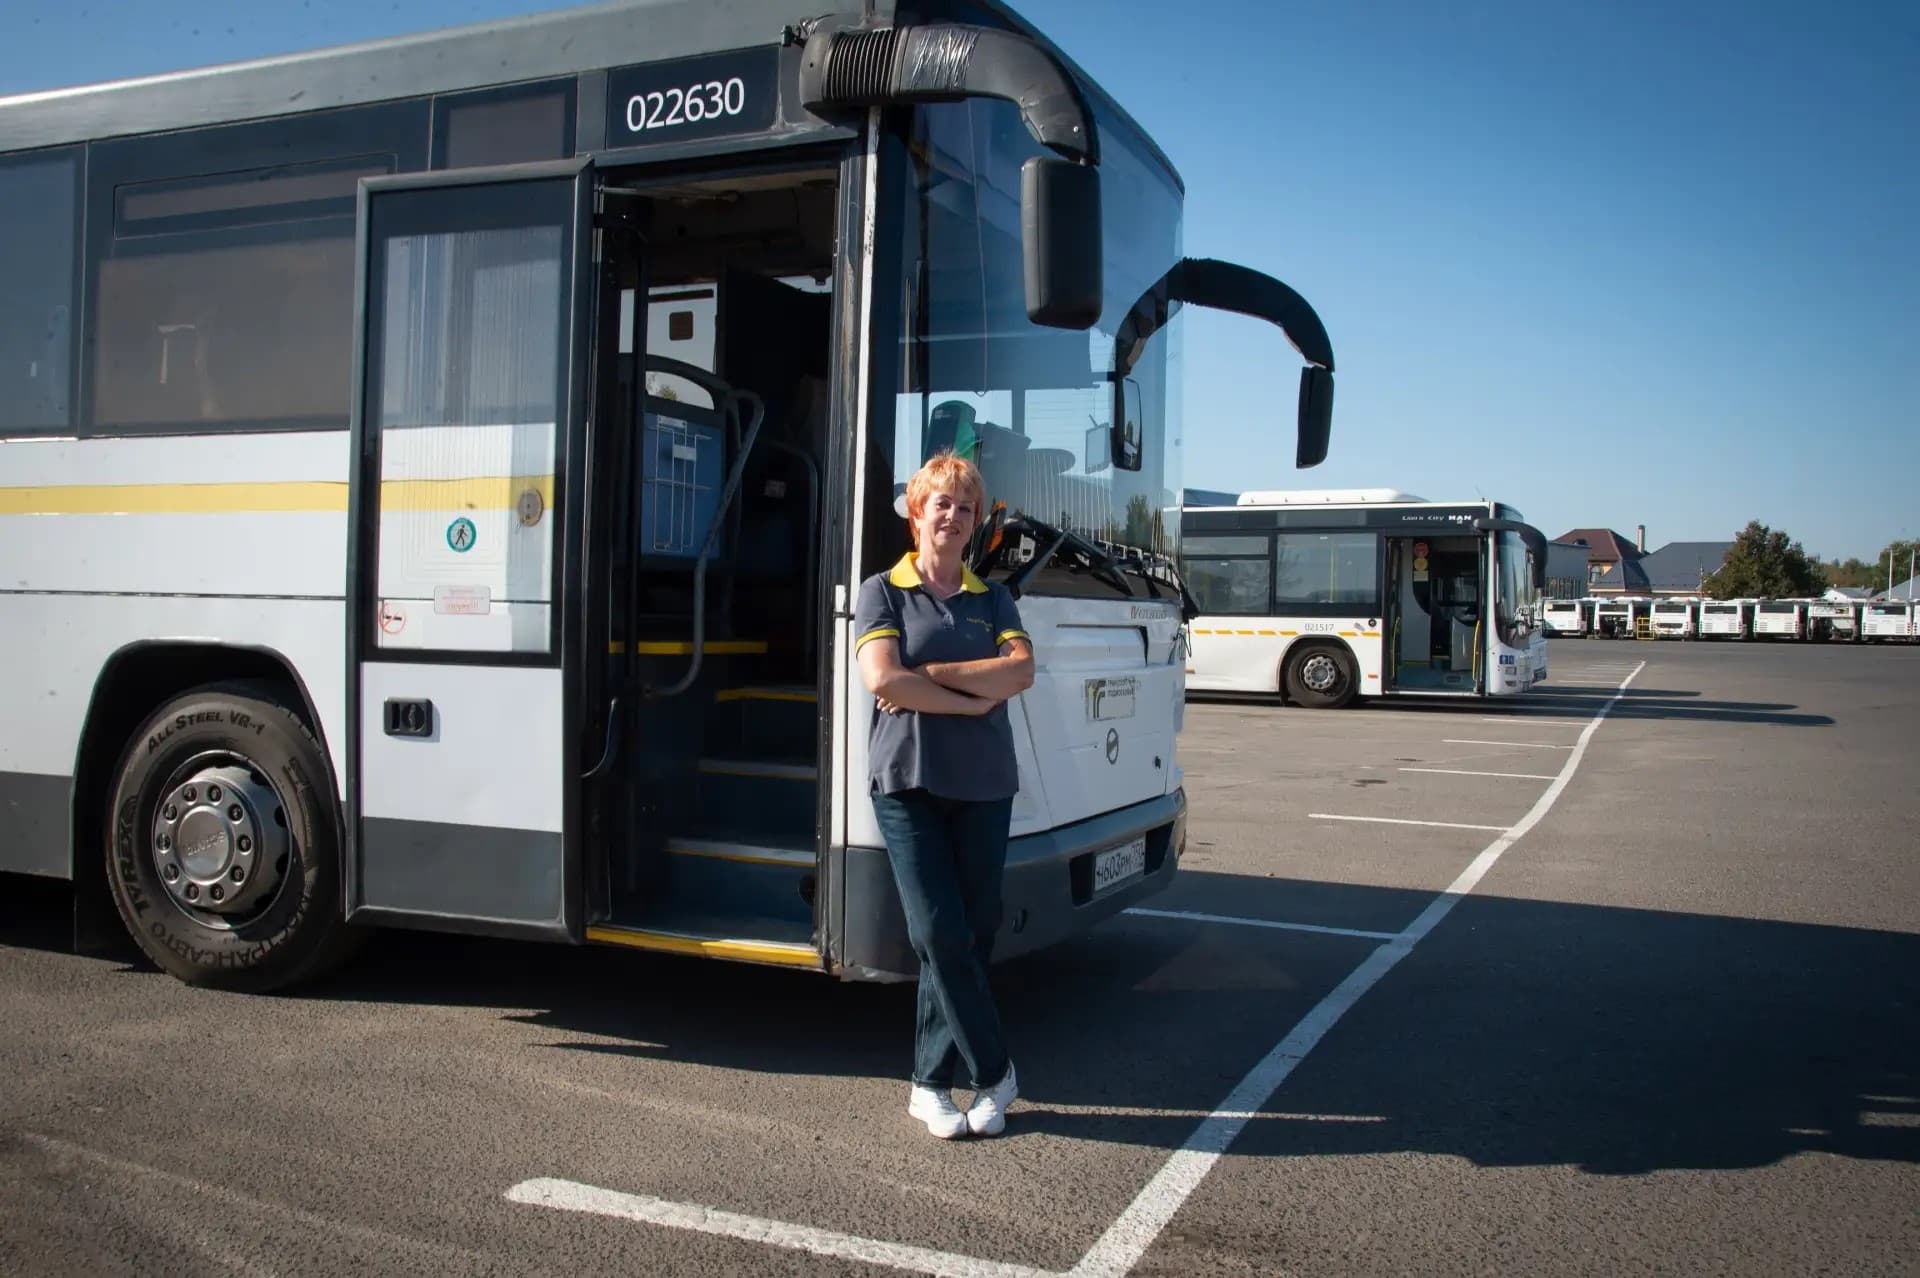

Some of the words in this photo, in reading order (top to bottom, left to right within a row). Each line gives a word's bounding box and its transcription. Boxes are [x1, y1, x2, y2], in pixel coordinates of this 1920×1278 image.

[627, 77, 744, 132] 022630
[176, 712, 224, 729] STEEL
[230, 710, 264, 735] VR-1
